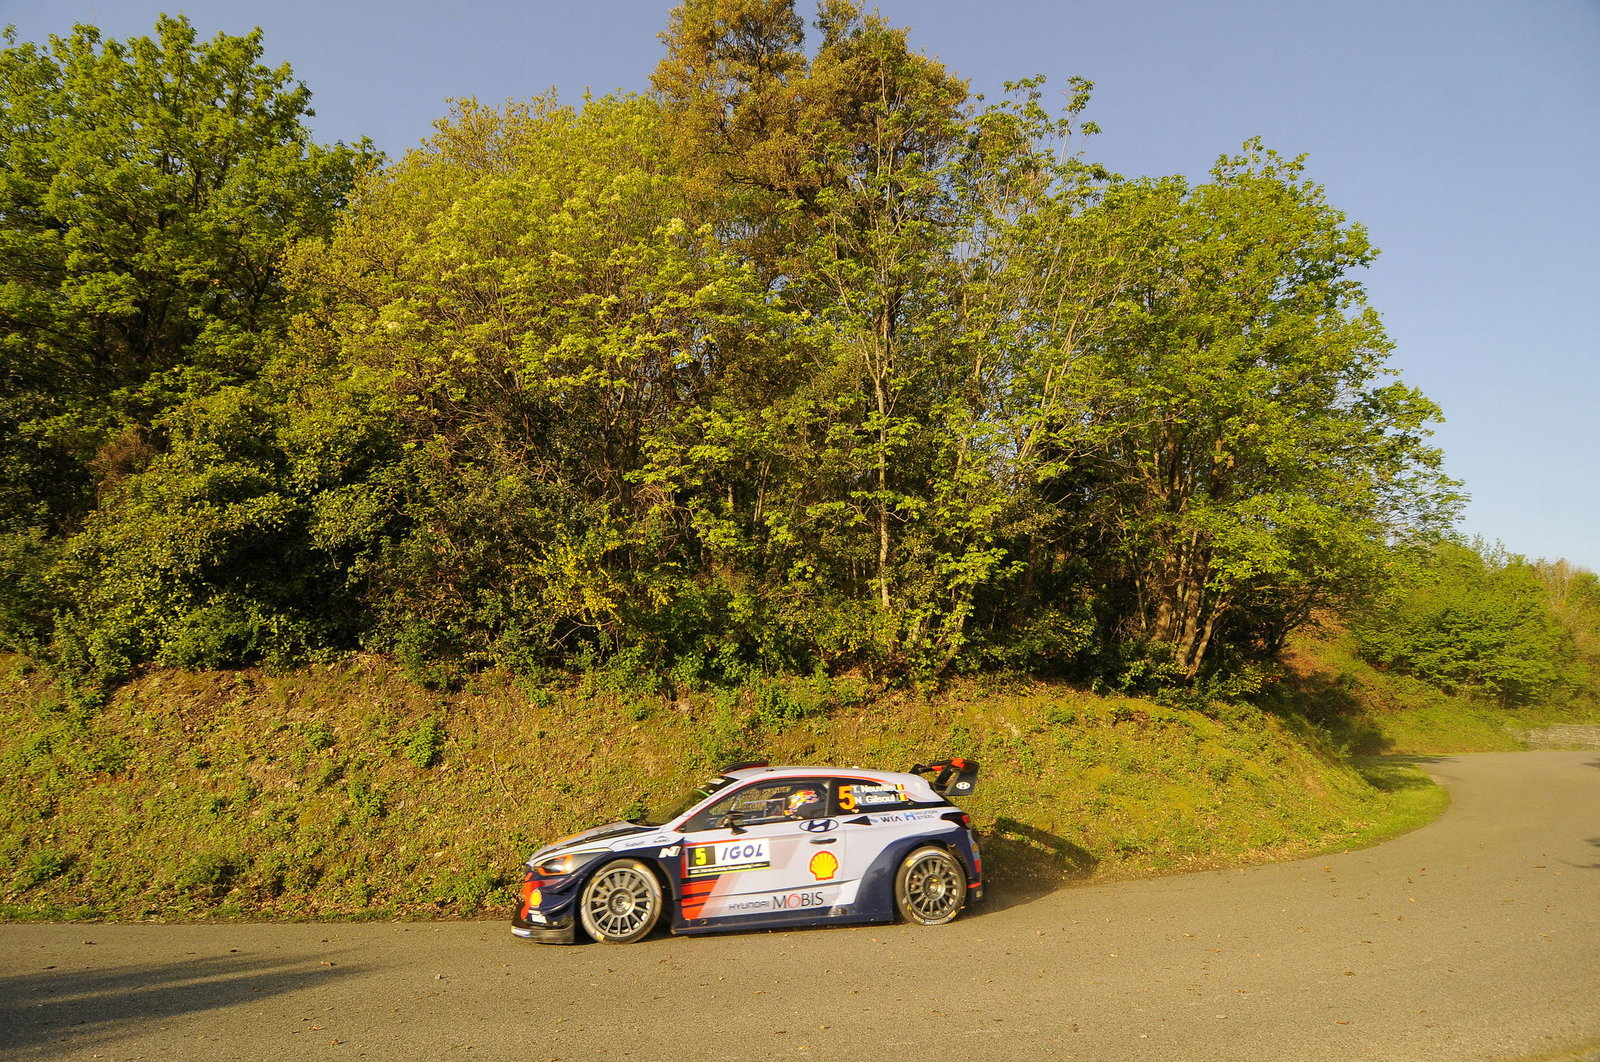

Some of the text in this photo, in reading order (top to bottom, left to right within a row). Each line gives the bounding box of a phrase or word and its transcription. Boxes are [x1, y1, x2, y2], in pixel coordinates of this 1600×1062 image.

[839, 785, 855, 810] 5
[866, 794, 896, 804] Gilsoul
[880, 815, 903, 823] WIA
[695, 844, 764, 866] 5 IGOL
[729, 892, 824, 910] HYUNDAI MOBIS
